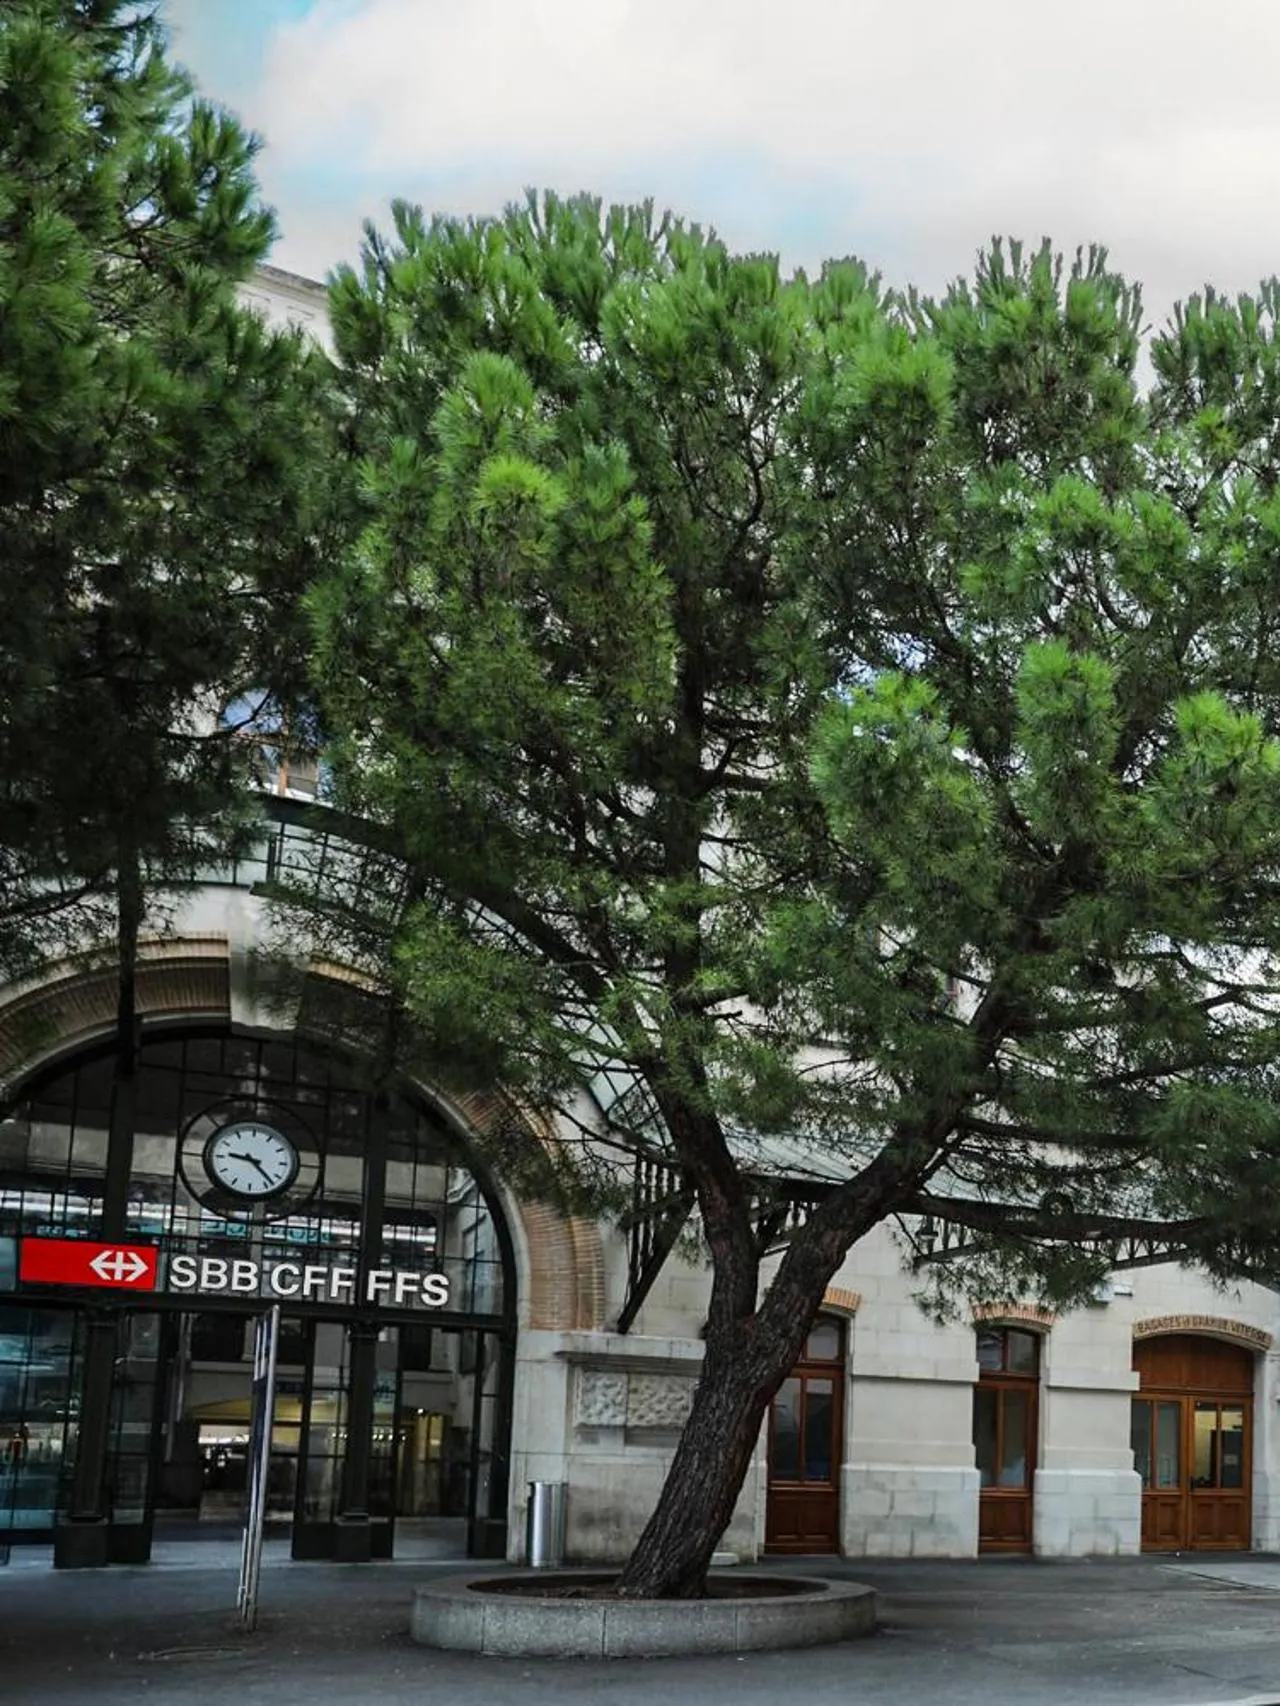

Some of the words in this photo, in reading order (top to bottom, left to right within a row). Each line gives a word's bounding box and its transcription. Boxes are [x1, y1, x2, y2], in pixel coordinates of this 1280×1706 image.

[170, 1255, 259, 1292] SBB
[270, 1263, 356, 1299] CFF
[367, 1270, 450, 1307] FFS
